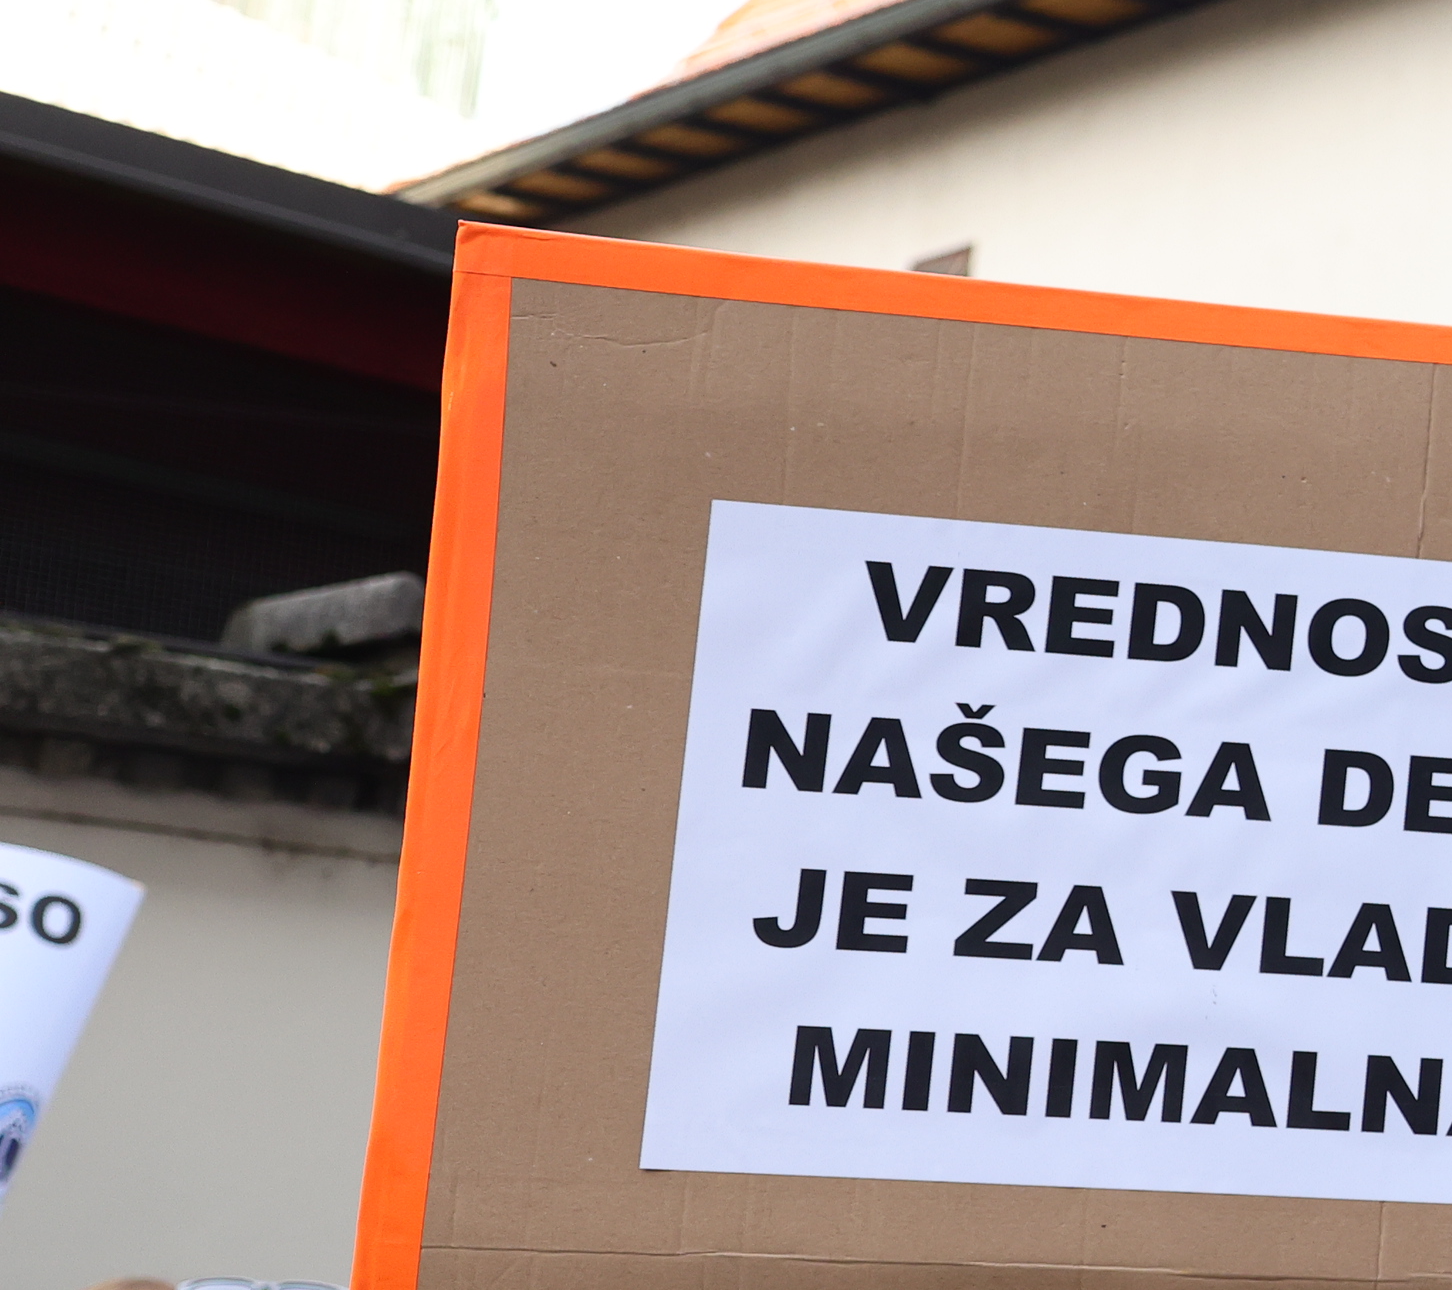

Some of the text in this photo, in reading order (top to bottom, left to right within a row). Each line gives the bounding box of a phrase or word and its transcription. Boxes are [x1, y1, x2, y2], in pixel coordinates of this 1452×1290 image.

[741, 702, 1271, 822] NAŠEGA
[752, 869, 914, 953] JE
[952, 879, 1124, 966] ZA
